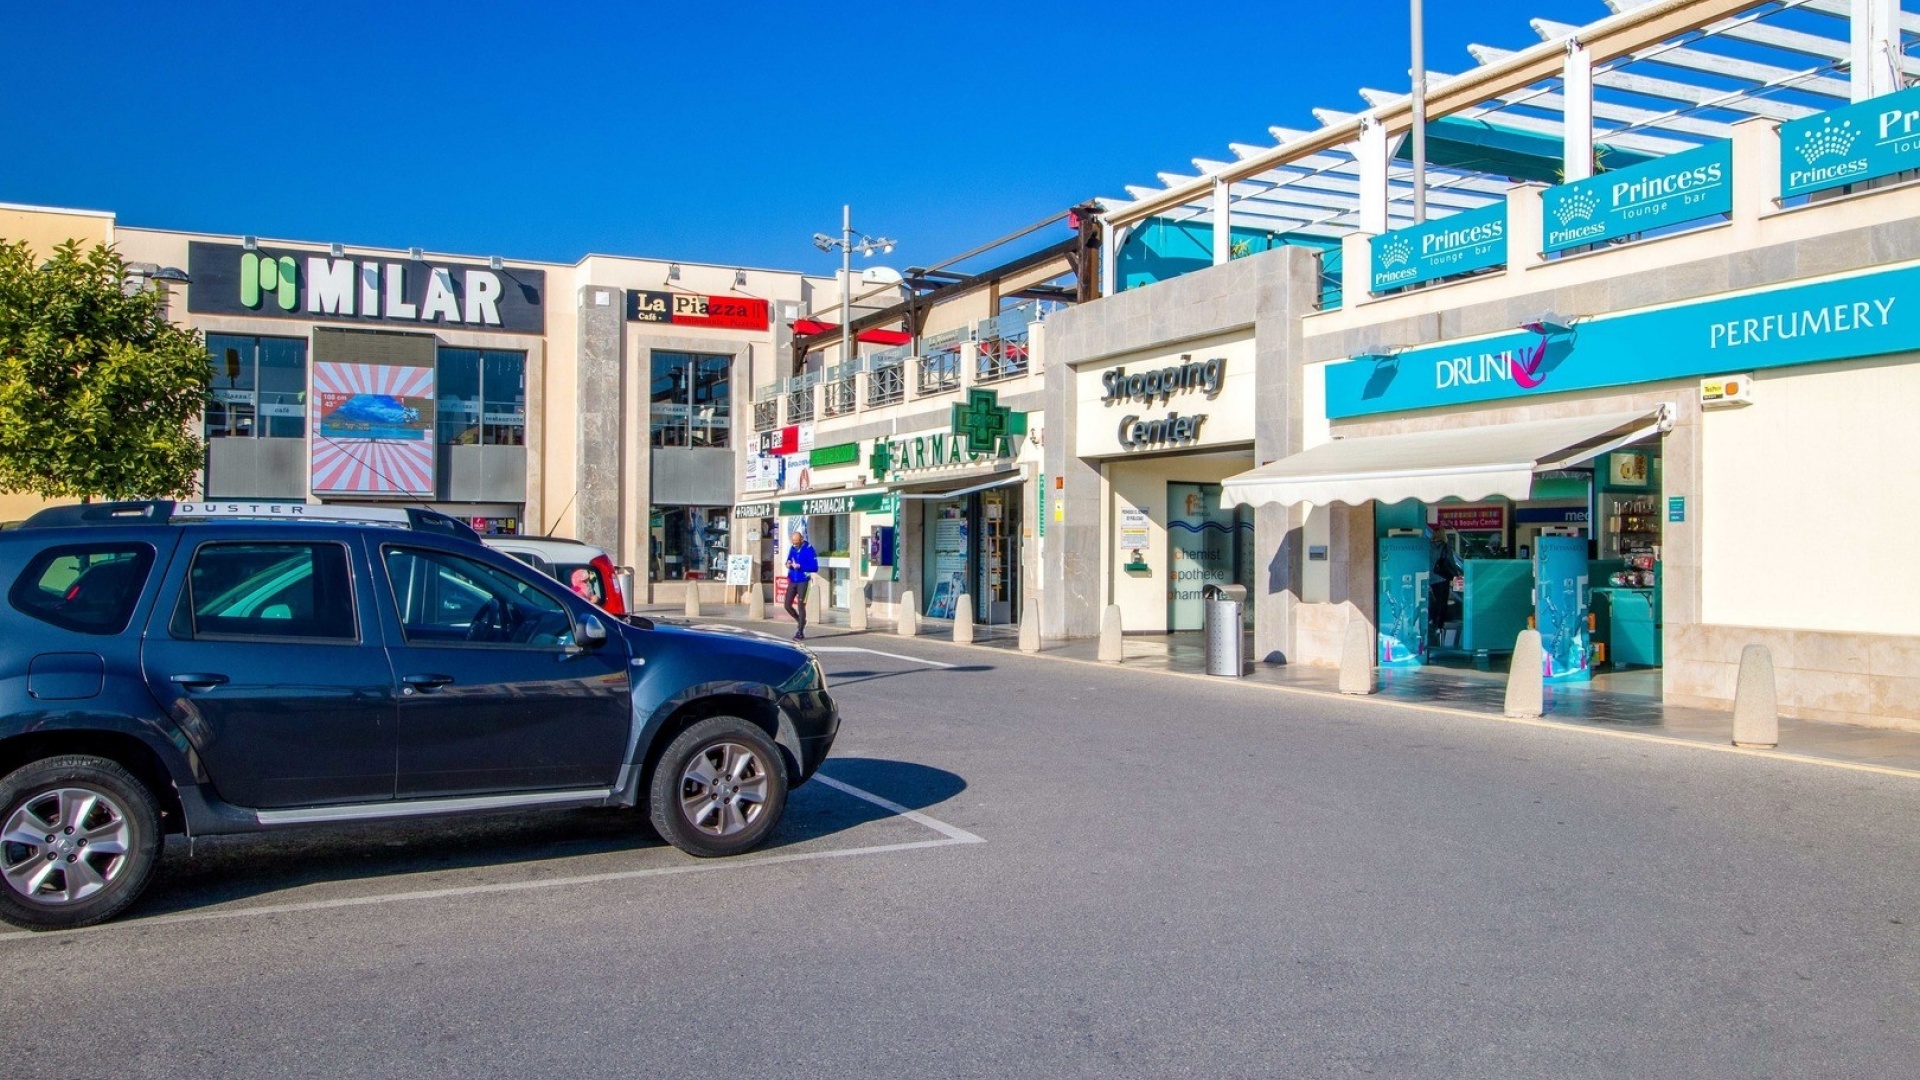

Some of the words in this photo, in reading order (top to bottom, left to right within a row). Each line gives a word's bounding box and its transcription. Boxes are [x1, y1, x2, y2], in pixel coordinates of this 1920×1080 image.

[1612, 162, 1722, 206] Princess
[1790, 158, 1868, 187] Princess
[1623, 201, 1668, 219] lounge
[1684, 192, 1706, 205] bar
[1422, 220, 1503, 254] Princess
[1550, 221, 1605, 244] Princess
[1430, 252, 1463, 265] lounge
[1475, 244, 1491, 255] bar
[1375, 266, 1417, 284] Princess
[307, 257, 501, 324] MILAR
[637, 293, 666, 312] La
[675, 296, 748, 317] Piazza
[638, 312, 657, 321] Café
[1710, 296, 1896, 349] PERFUMERY
[1101, 354, 1227, 404] Shopping
[1436, 350, 1512, 389] DRUNI
[1118, 412, 1208, 448] Center
[761, 436, 770, 449] La
[888, 432, 1013, 469] FARMAA
[182, 504, 303, 514] DUSTER
[740, 506, 765, 518] FARMACIA
[809, 497, 846, 513] FARMACIA
[1175, 547, 1222, 560] chemist
[1170, 568, 1224, 583] apotheke
